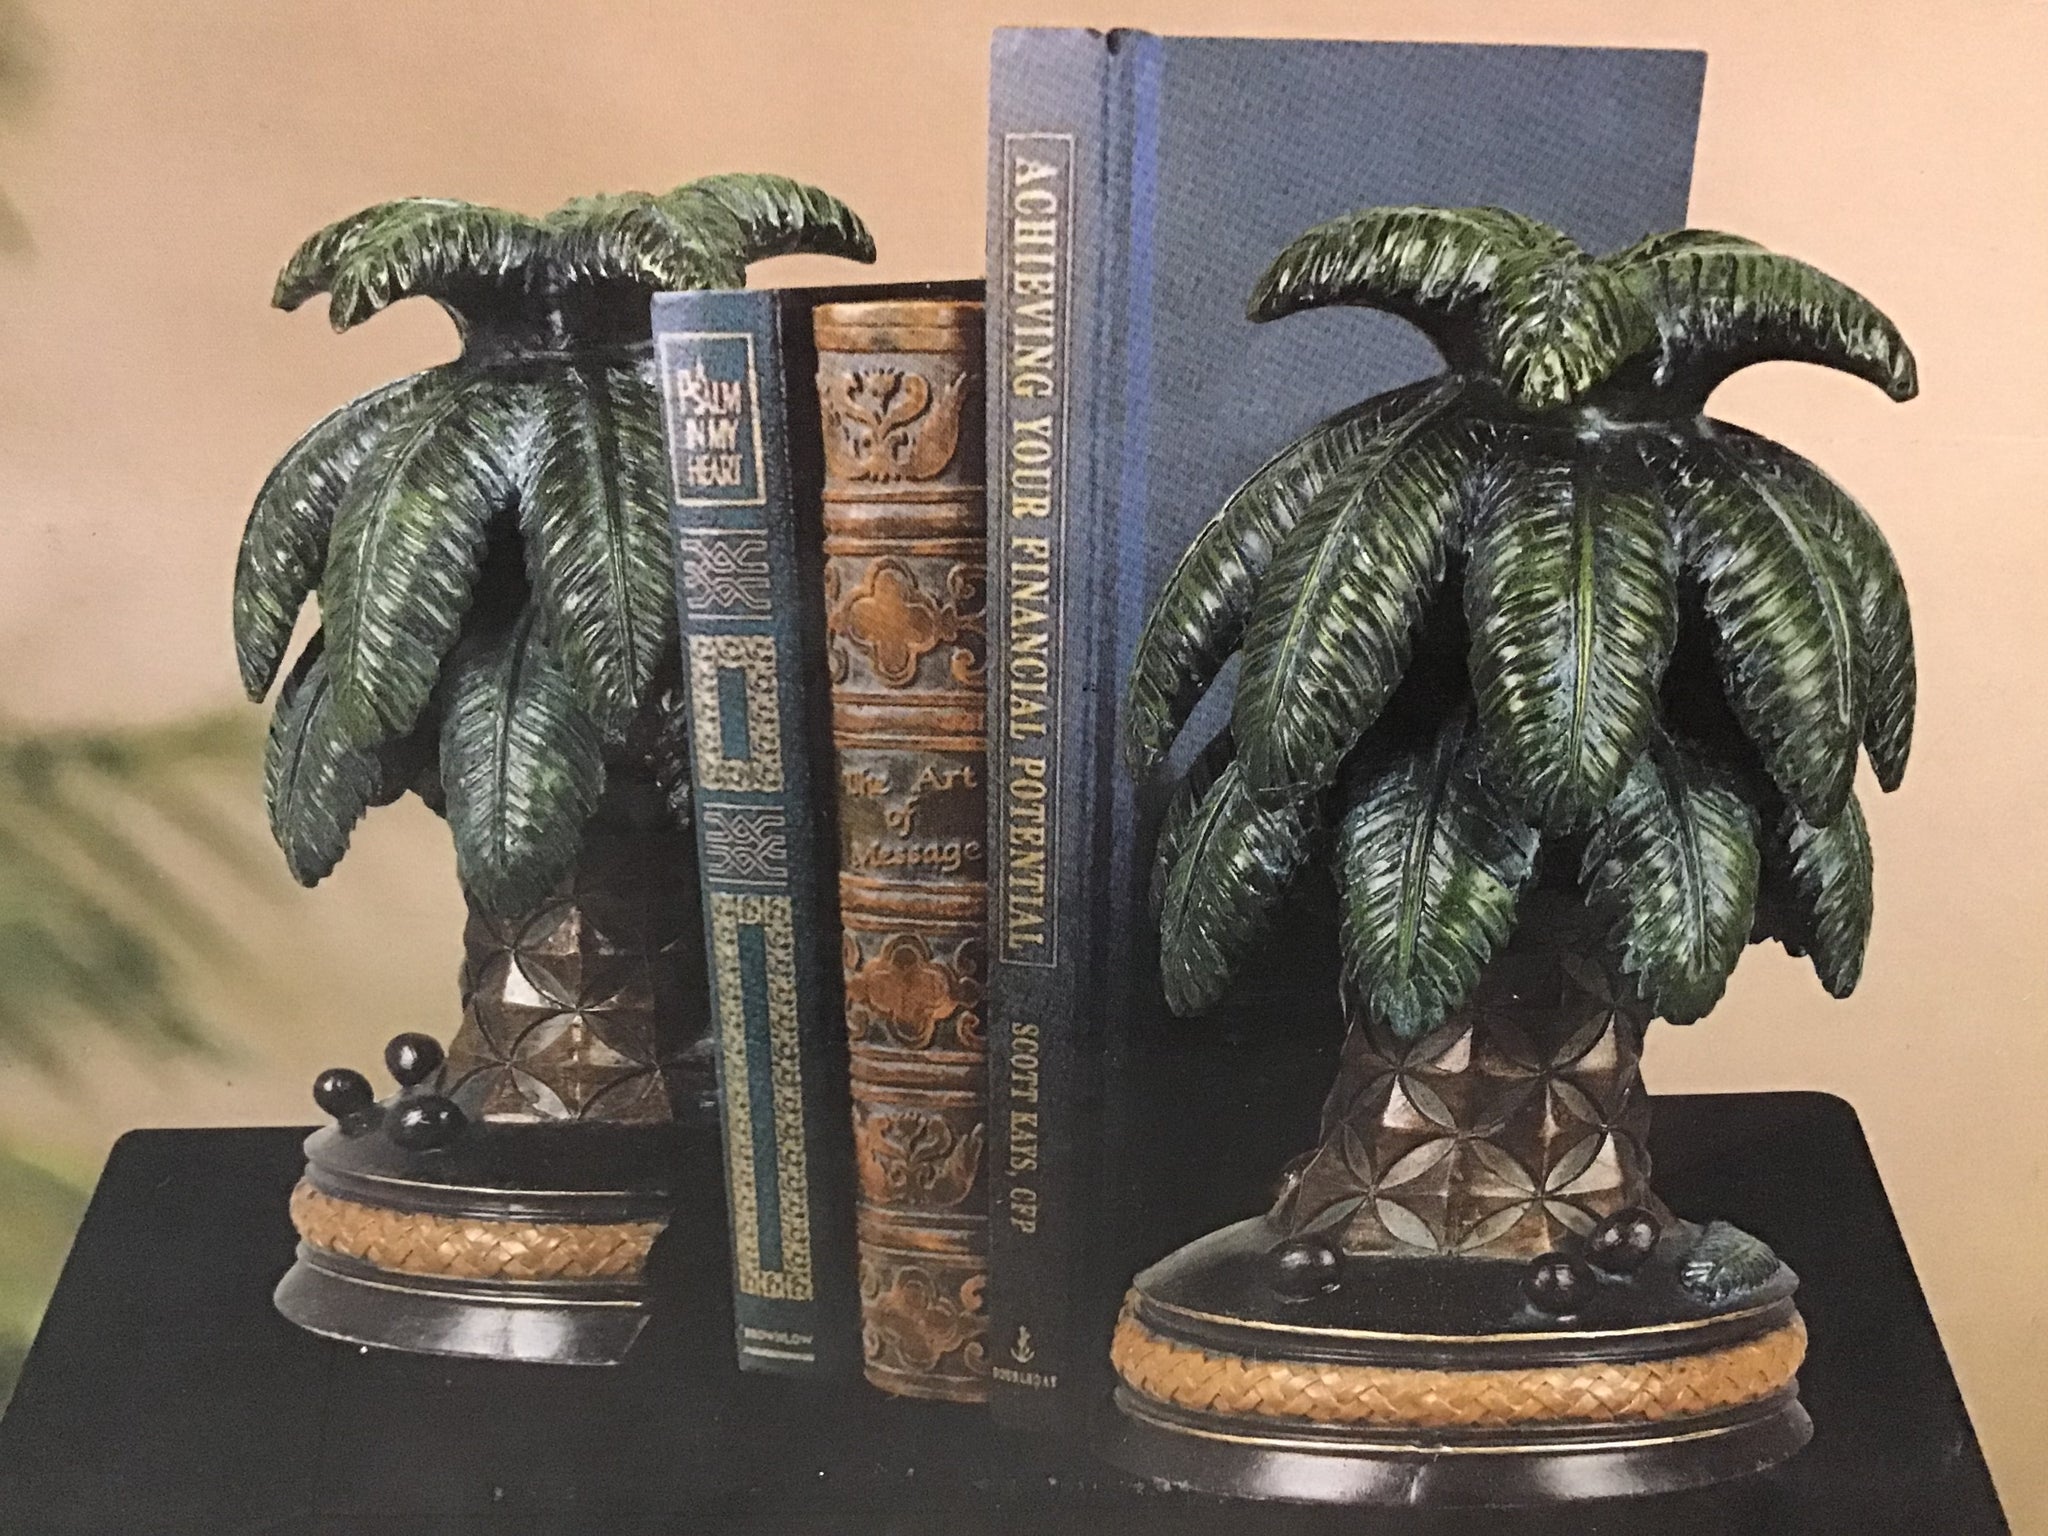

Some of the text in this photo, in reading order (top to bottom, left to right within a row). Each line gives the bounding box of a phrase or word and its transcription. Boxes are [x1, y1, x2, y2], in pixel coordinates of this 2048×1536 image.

[708, 417, 739, 450] MY
[688, 454, 742, 486] HEART
[1008, 157, 1056, 948] ACHIEVING YOUR FINANCIAL POTENTIAL
[910, 766, 977, 794] Art
[885, 796, 919, 837] of
[1005, 1022, 1040, 1234] SCOTT KAYS, CFP
